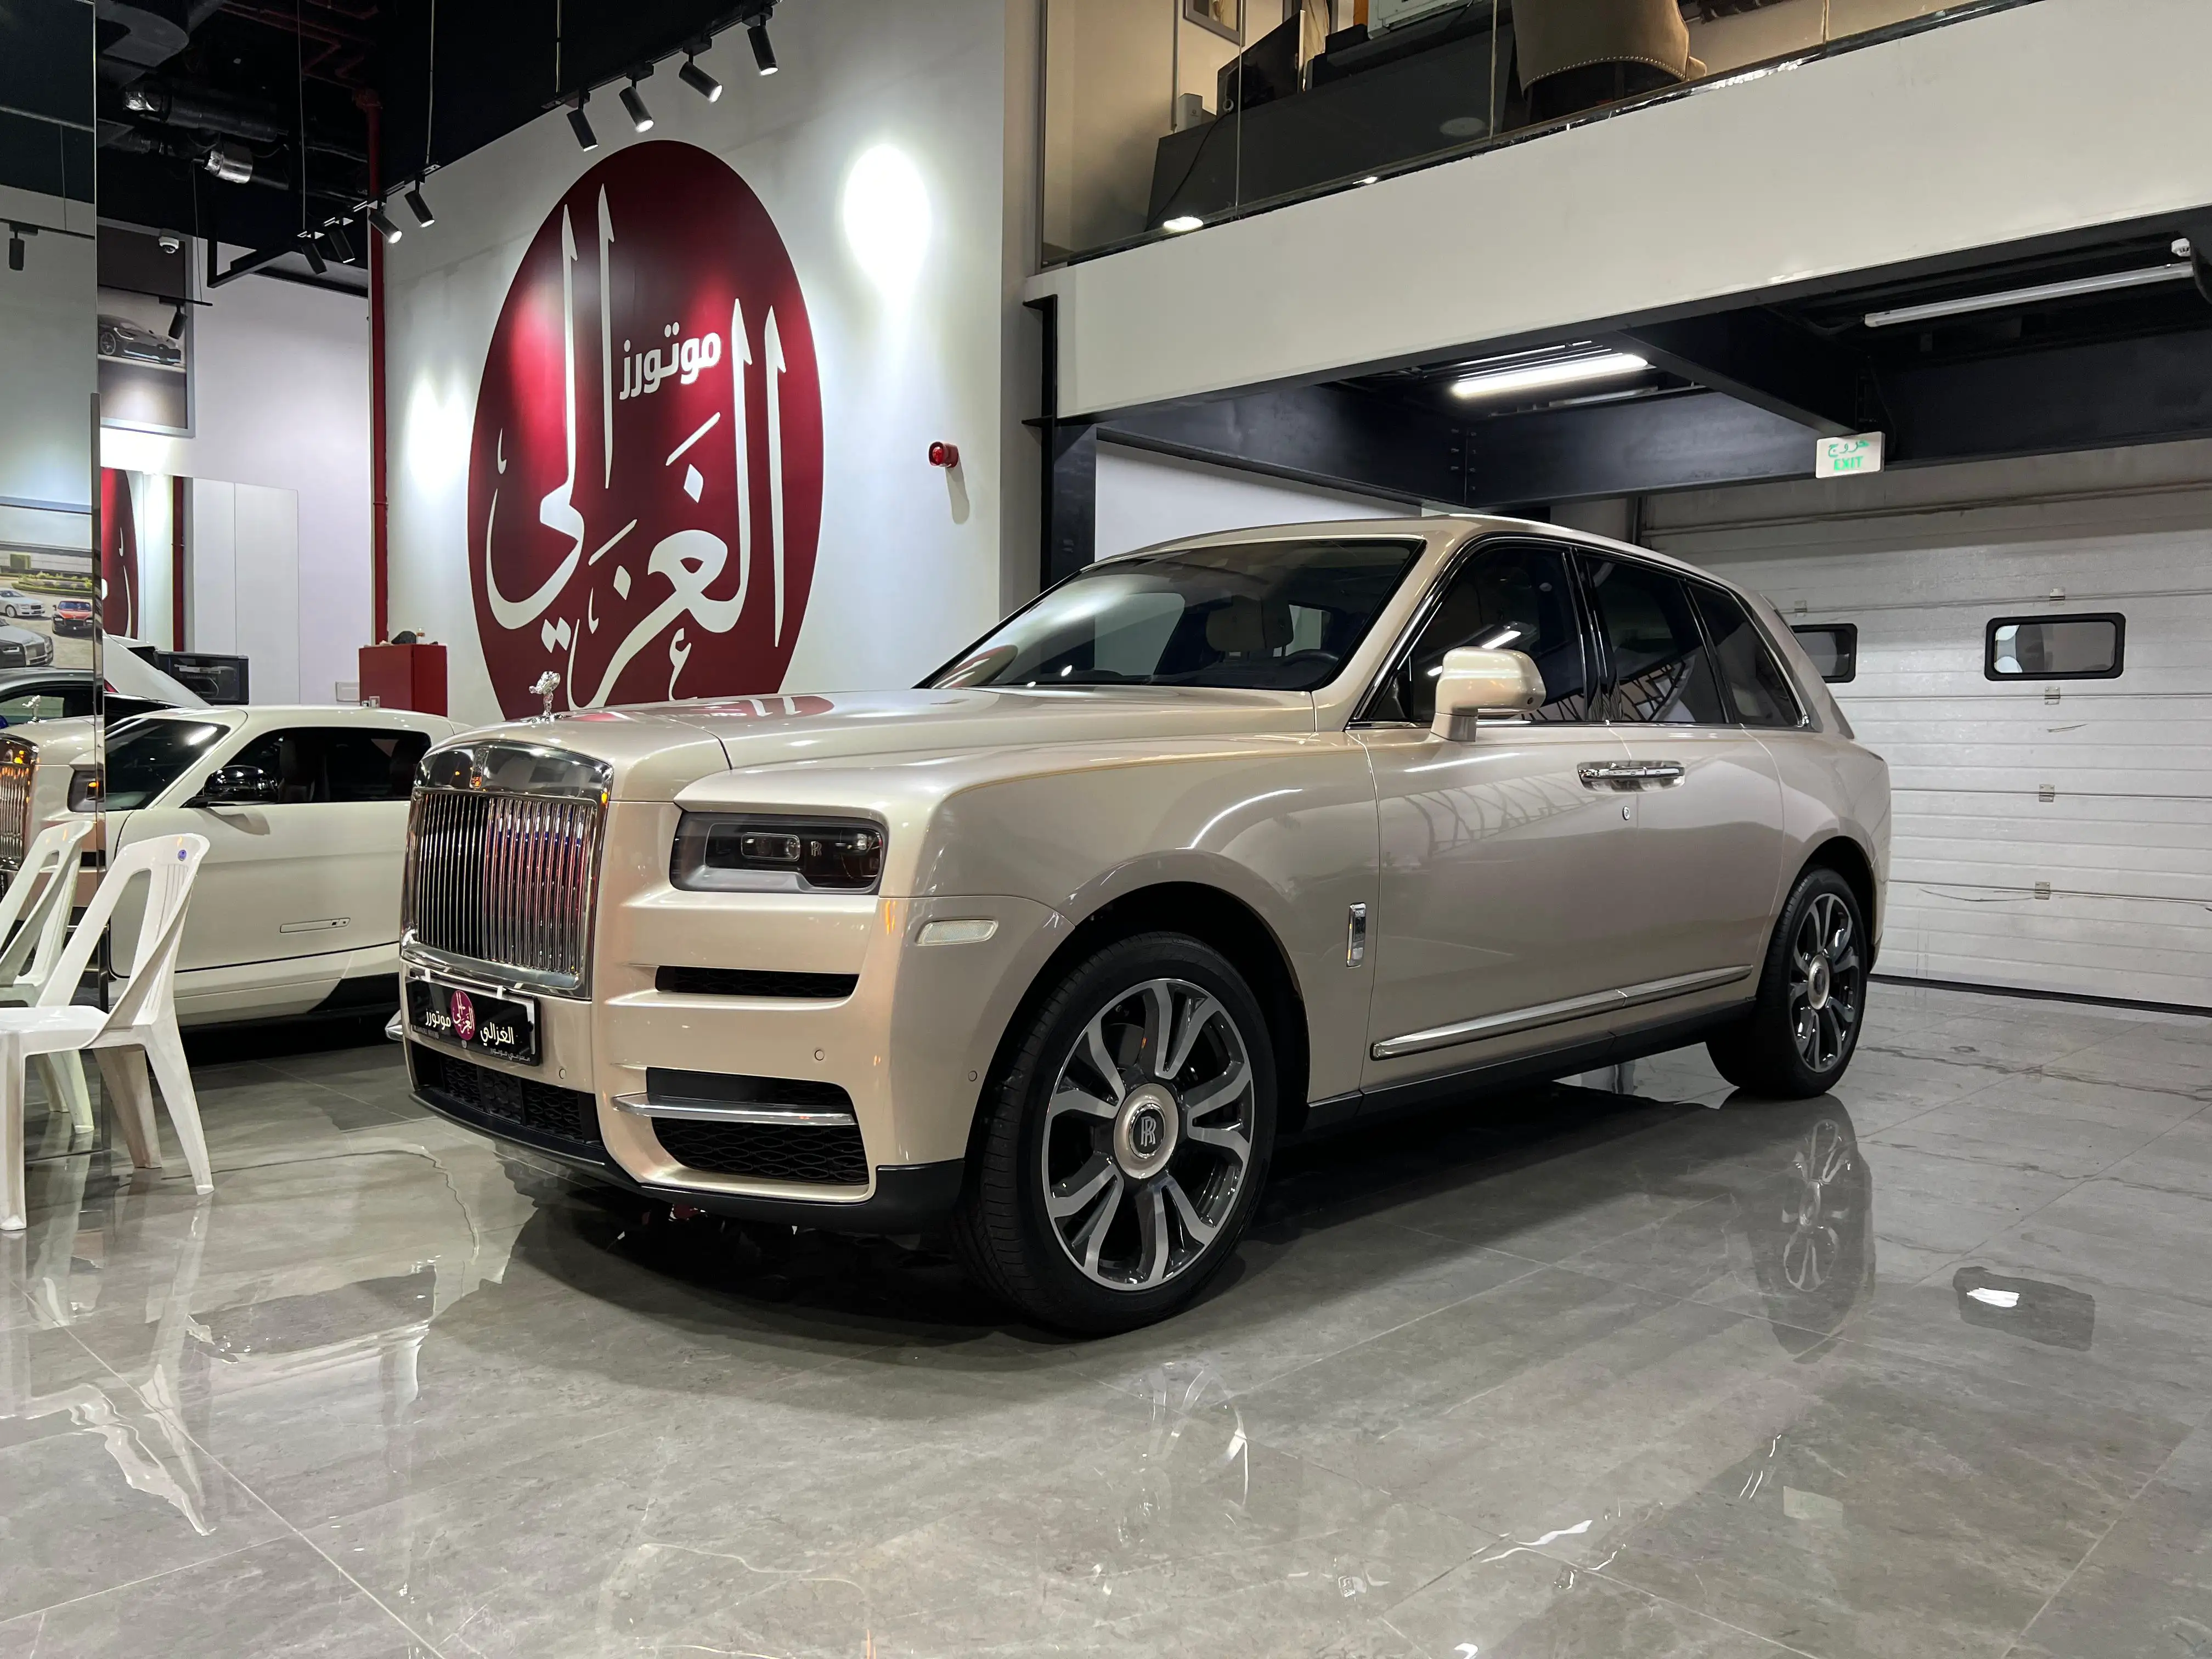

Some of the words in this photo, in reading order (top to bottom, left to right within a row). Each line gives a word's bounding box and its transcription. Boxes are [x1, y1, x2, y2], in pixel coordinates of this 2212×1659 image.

[619, 321, 721, 399] موتورز
[1834, 456, 1864, 471] EXIT
[425, 1008, 451, 1030] موتورز
[480, 1022, 514, 1046] الغزالي
